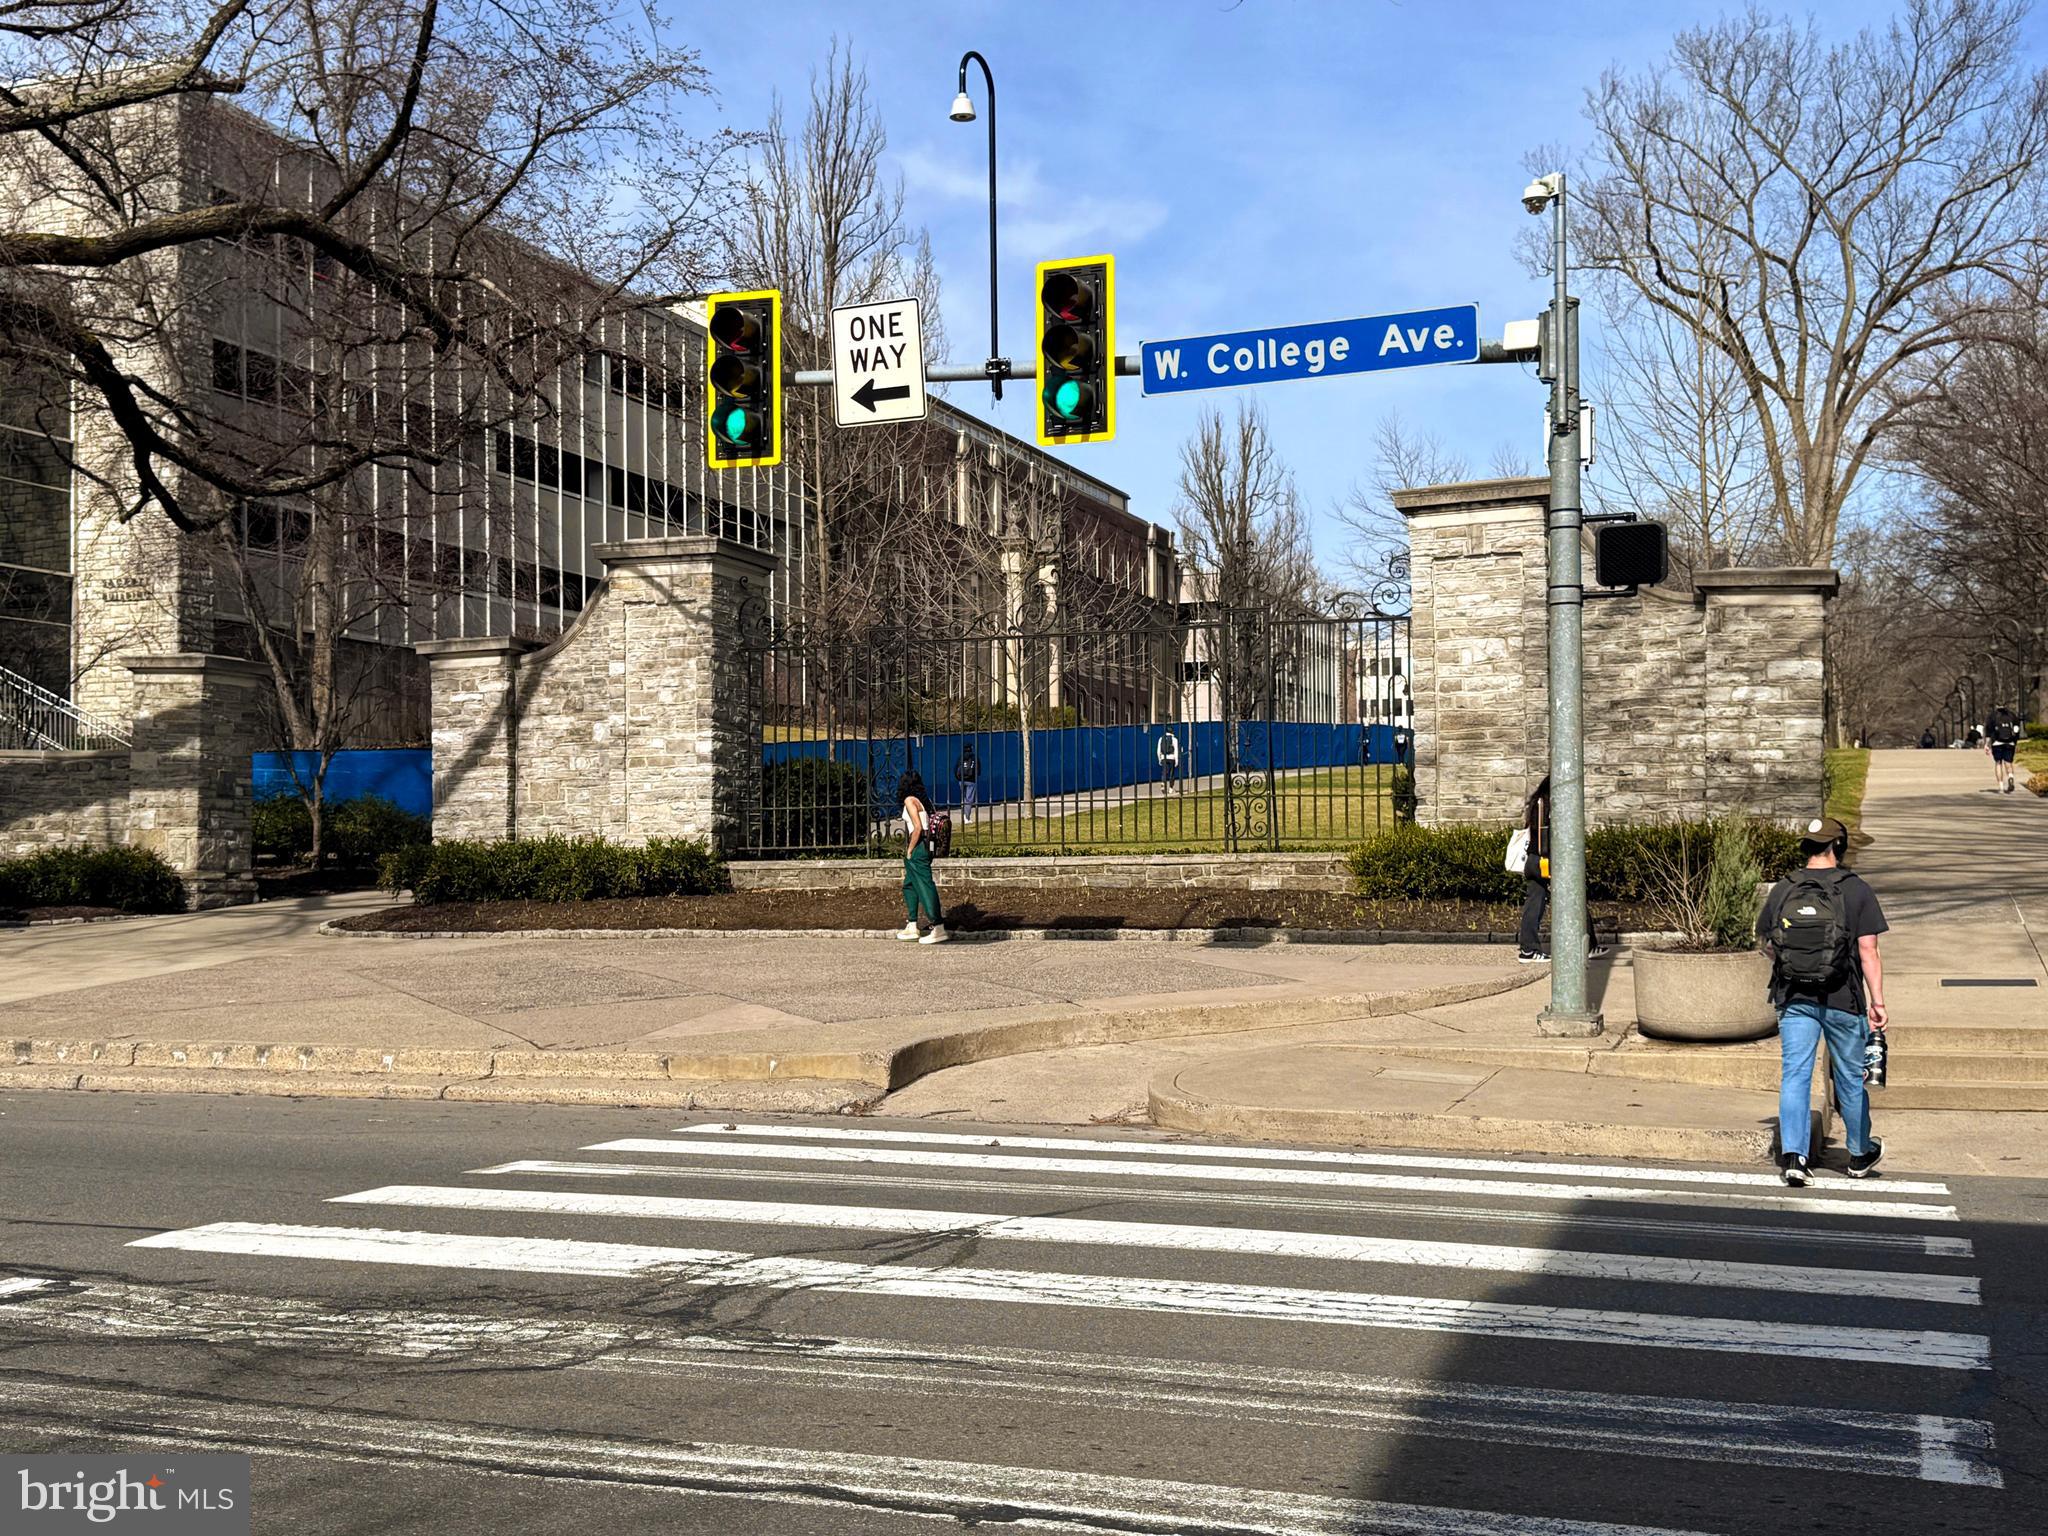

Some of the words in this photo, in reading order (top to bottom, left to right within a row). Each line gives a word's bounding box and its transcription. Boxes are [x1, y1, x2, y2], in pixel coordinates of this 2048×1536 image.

[850, 312, 903, 342] ONE
[850, 343, 907, 373] WAY
[1154, 348, 1188, 380] W.
[1207, 336, 1350, 373] College
[1379, 323, 1464, 356] Ave.
